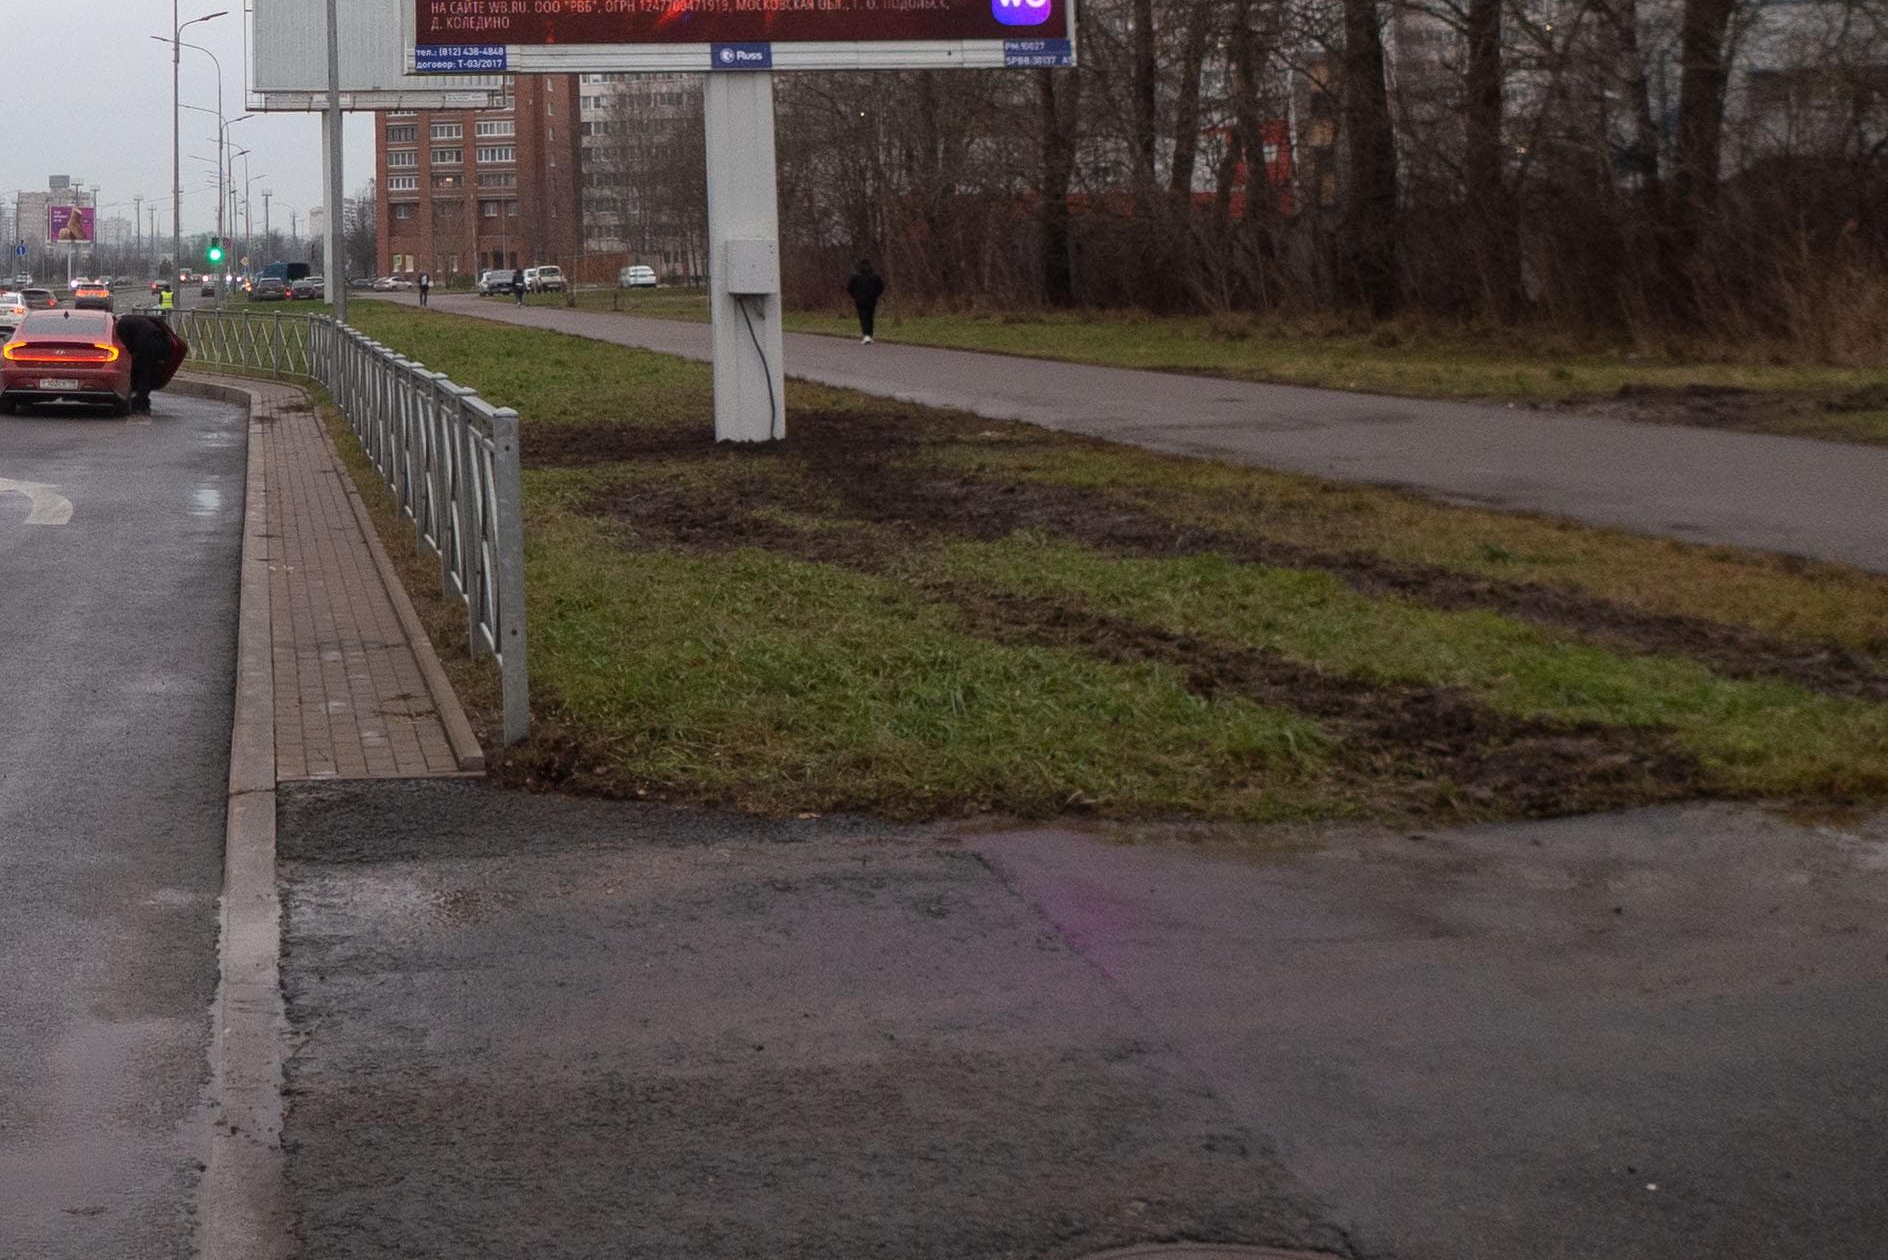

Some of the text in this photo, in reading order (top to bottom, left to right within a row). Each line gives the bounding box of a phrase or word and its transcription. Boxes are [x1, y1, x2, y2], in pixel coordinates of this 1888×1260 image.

[431, 1, 446, 14] НА
[450, 0, 485, 13] САЙТЕ
[488, 0, 530, 13] WB.RU.
[535, 0, 560, 13] ООО
[605, 0, 635, 13] ОГРН
[431, 16, 510, 30] Д. КОЛЕДИНО
[439, 47, 461, 56] (812)
[462, 47, 504, 56] 438-4848
[736, 50, 763, 61] Russ
